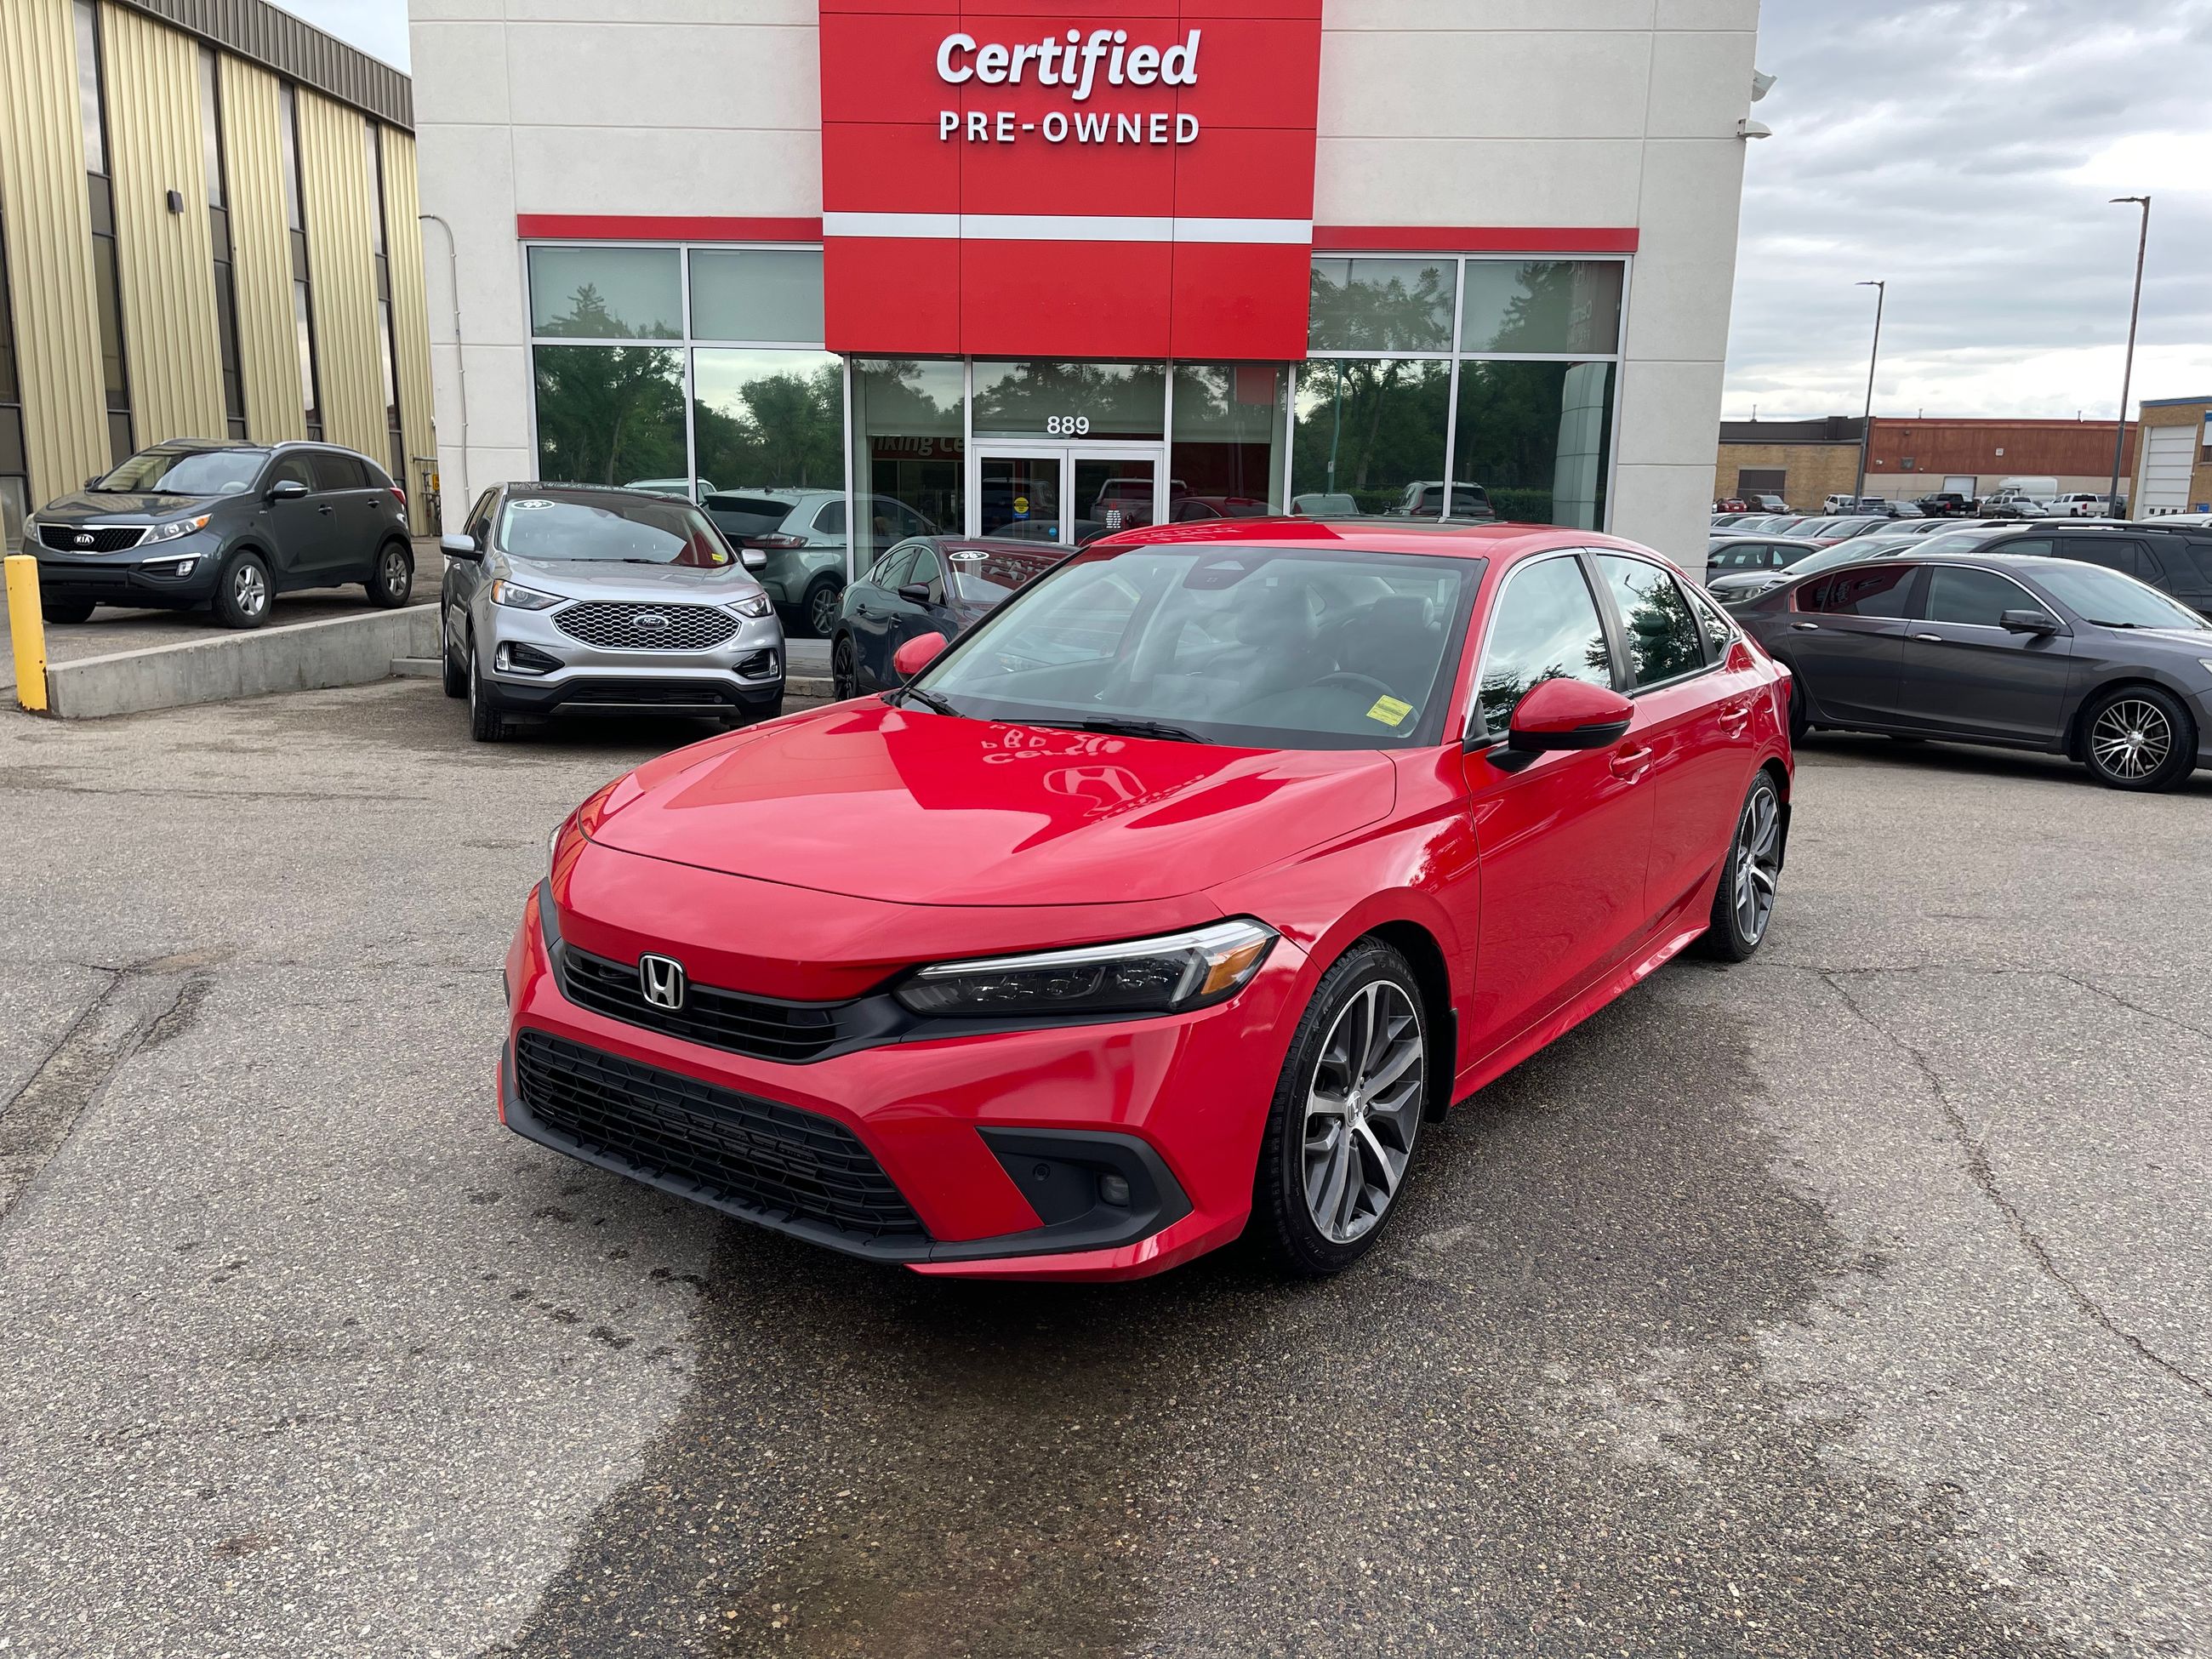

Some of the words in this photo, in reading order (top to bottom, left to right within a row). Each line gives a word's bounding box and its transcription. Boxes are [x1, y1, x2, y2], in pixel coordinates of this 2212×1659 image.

[937, 28, 1201, 100] Certified
[939, 111, 1200, 144] PRE-OWNED
[1046, 415, 1090, 435] 889
[76, 535, 92, 544] KIA
